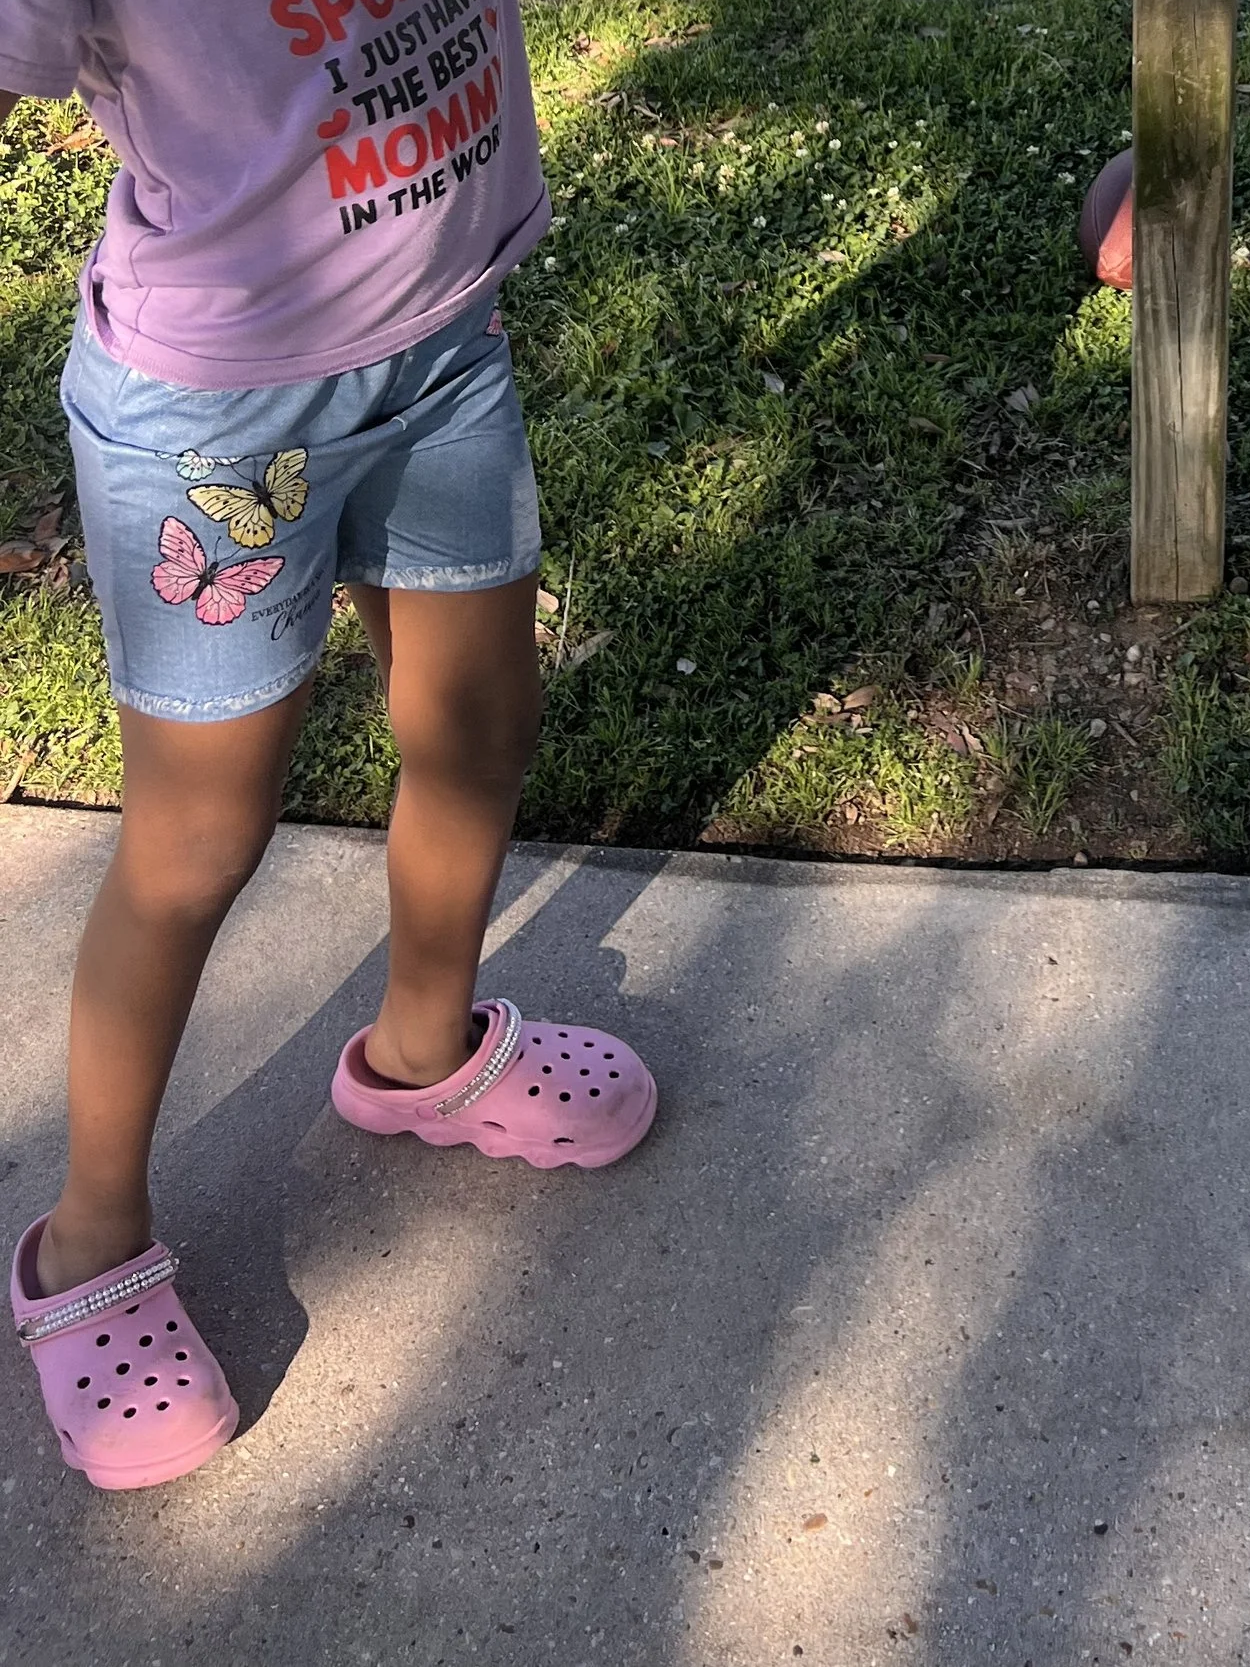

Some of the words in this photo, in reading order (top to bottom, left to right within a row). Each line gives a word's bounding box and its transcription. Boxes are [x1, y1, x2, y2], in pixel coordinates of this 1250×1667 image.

[323, 56, 349, 95] I
[360, 9, 430, 79] JUST
[352, 65, 429, 126] THE
[427, 13, 489, 92] BEST
[338, 198, 379, 235] IN
[387, 168, 448, 218] THE
